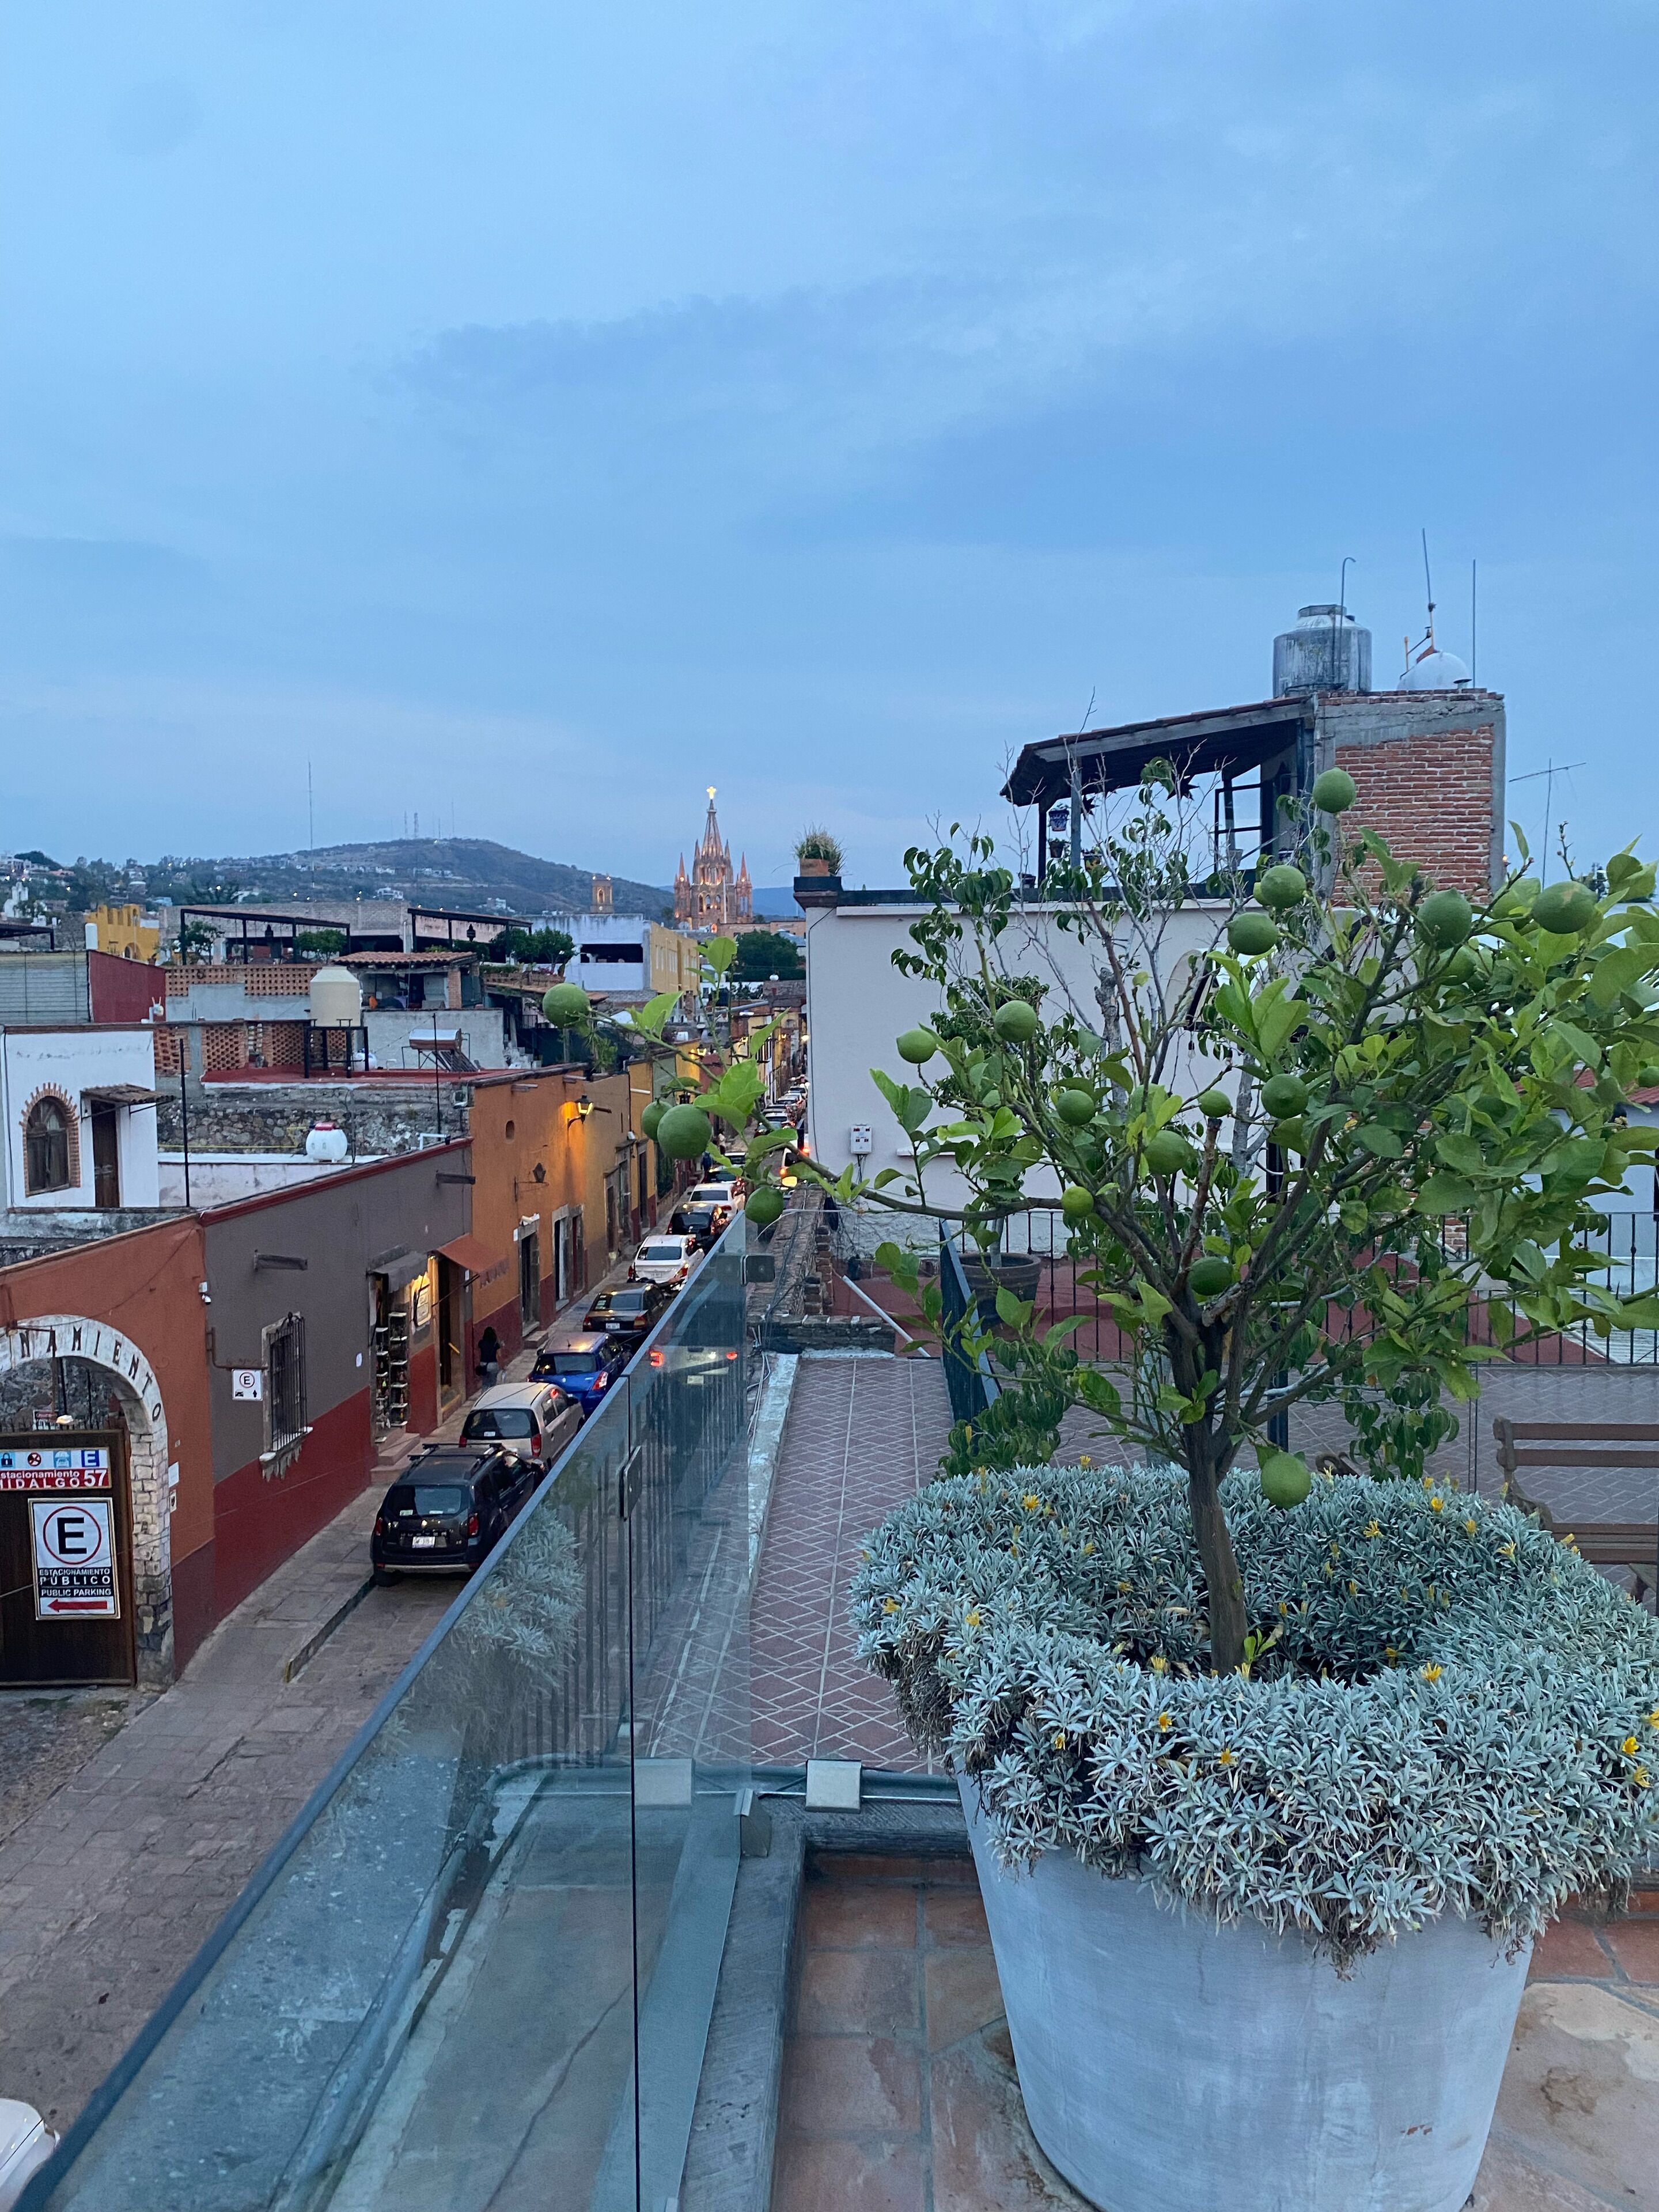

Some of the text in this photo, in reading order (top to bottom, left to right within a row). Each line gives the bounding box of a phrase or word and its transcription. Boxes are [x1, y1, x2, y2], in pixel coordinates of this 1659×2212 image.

[19, 1325, 161, 1422] NAMIENTO
[244, 1376, 251, 1385] E
[84, 1450, 97, 1466] E
[0, 1470, 80, 1480] stacionamiento
[84, 1469, 107, 1487] 57
[56, 1517, 88, 1555] E
[39, 1568, 110, 1576] ESTACIONAMIENTO
[74, 1588, 111, 1596] PARKING
